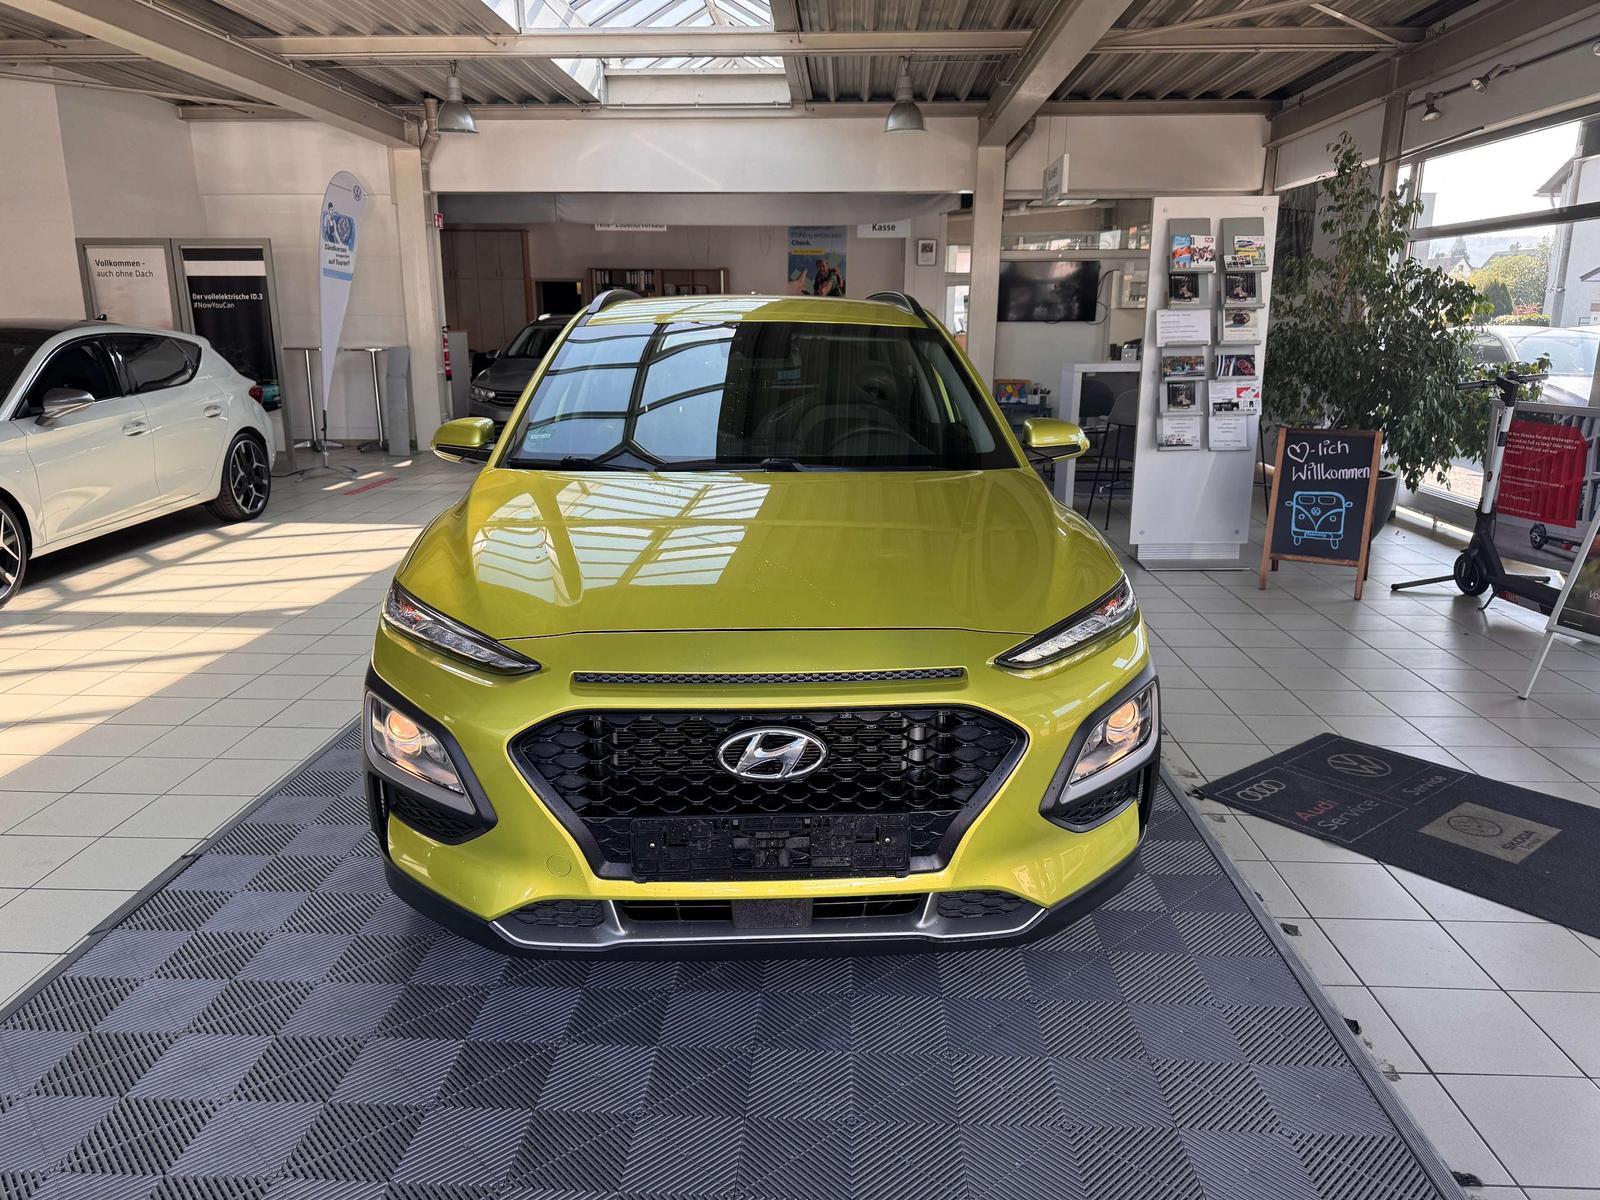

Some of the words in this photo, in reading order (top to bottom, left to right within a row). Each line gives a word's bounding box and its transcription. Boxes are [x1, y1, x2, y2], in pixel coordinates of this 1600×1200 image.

[872, 223, 896, 232] Kasse
[94, 259, 141, 268] Vollkommen
[96, 270, 114, 278] auch
[115, 270, 134, 278] ohne
[135, 269, 154, 278] Dach
[192, 293, 203, 301] Der
[204, 293, 249, 301] vollelektrische
[250, 293, 264, 301] ID.3
[193, 301, 235, 309] #NowYouCan
[1292, 461, 1371, 481] Willkommen
[1589, 590, 1600, 600] Vo
[1402, 775, 1447, 796] Service
[1295, 799, 1338, 822] Audi
[1316, 799, 1380, 831] Service
